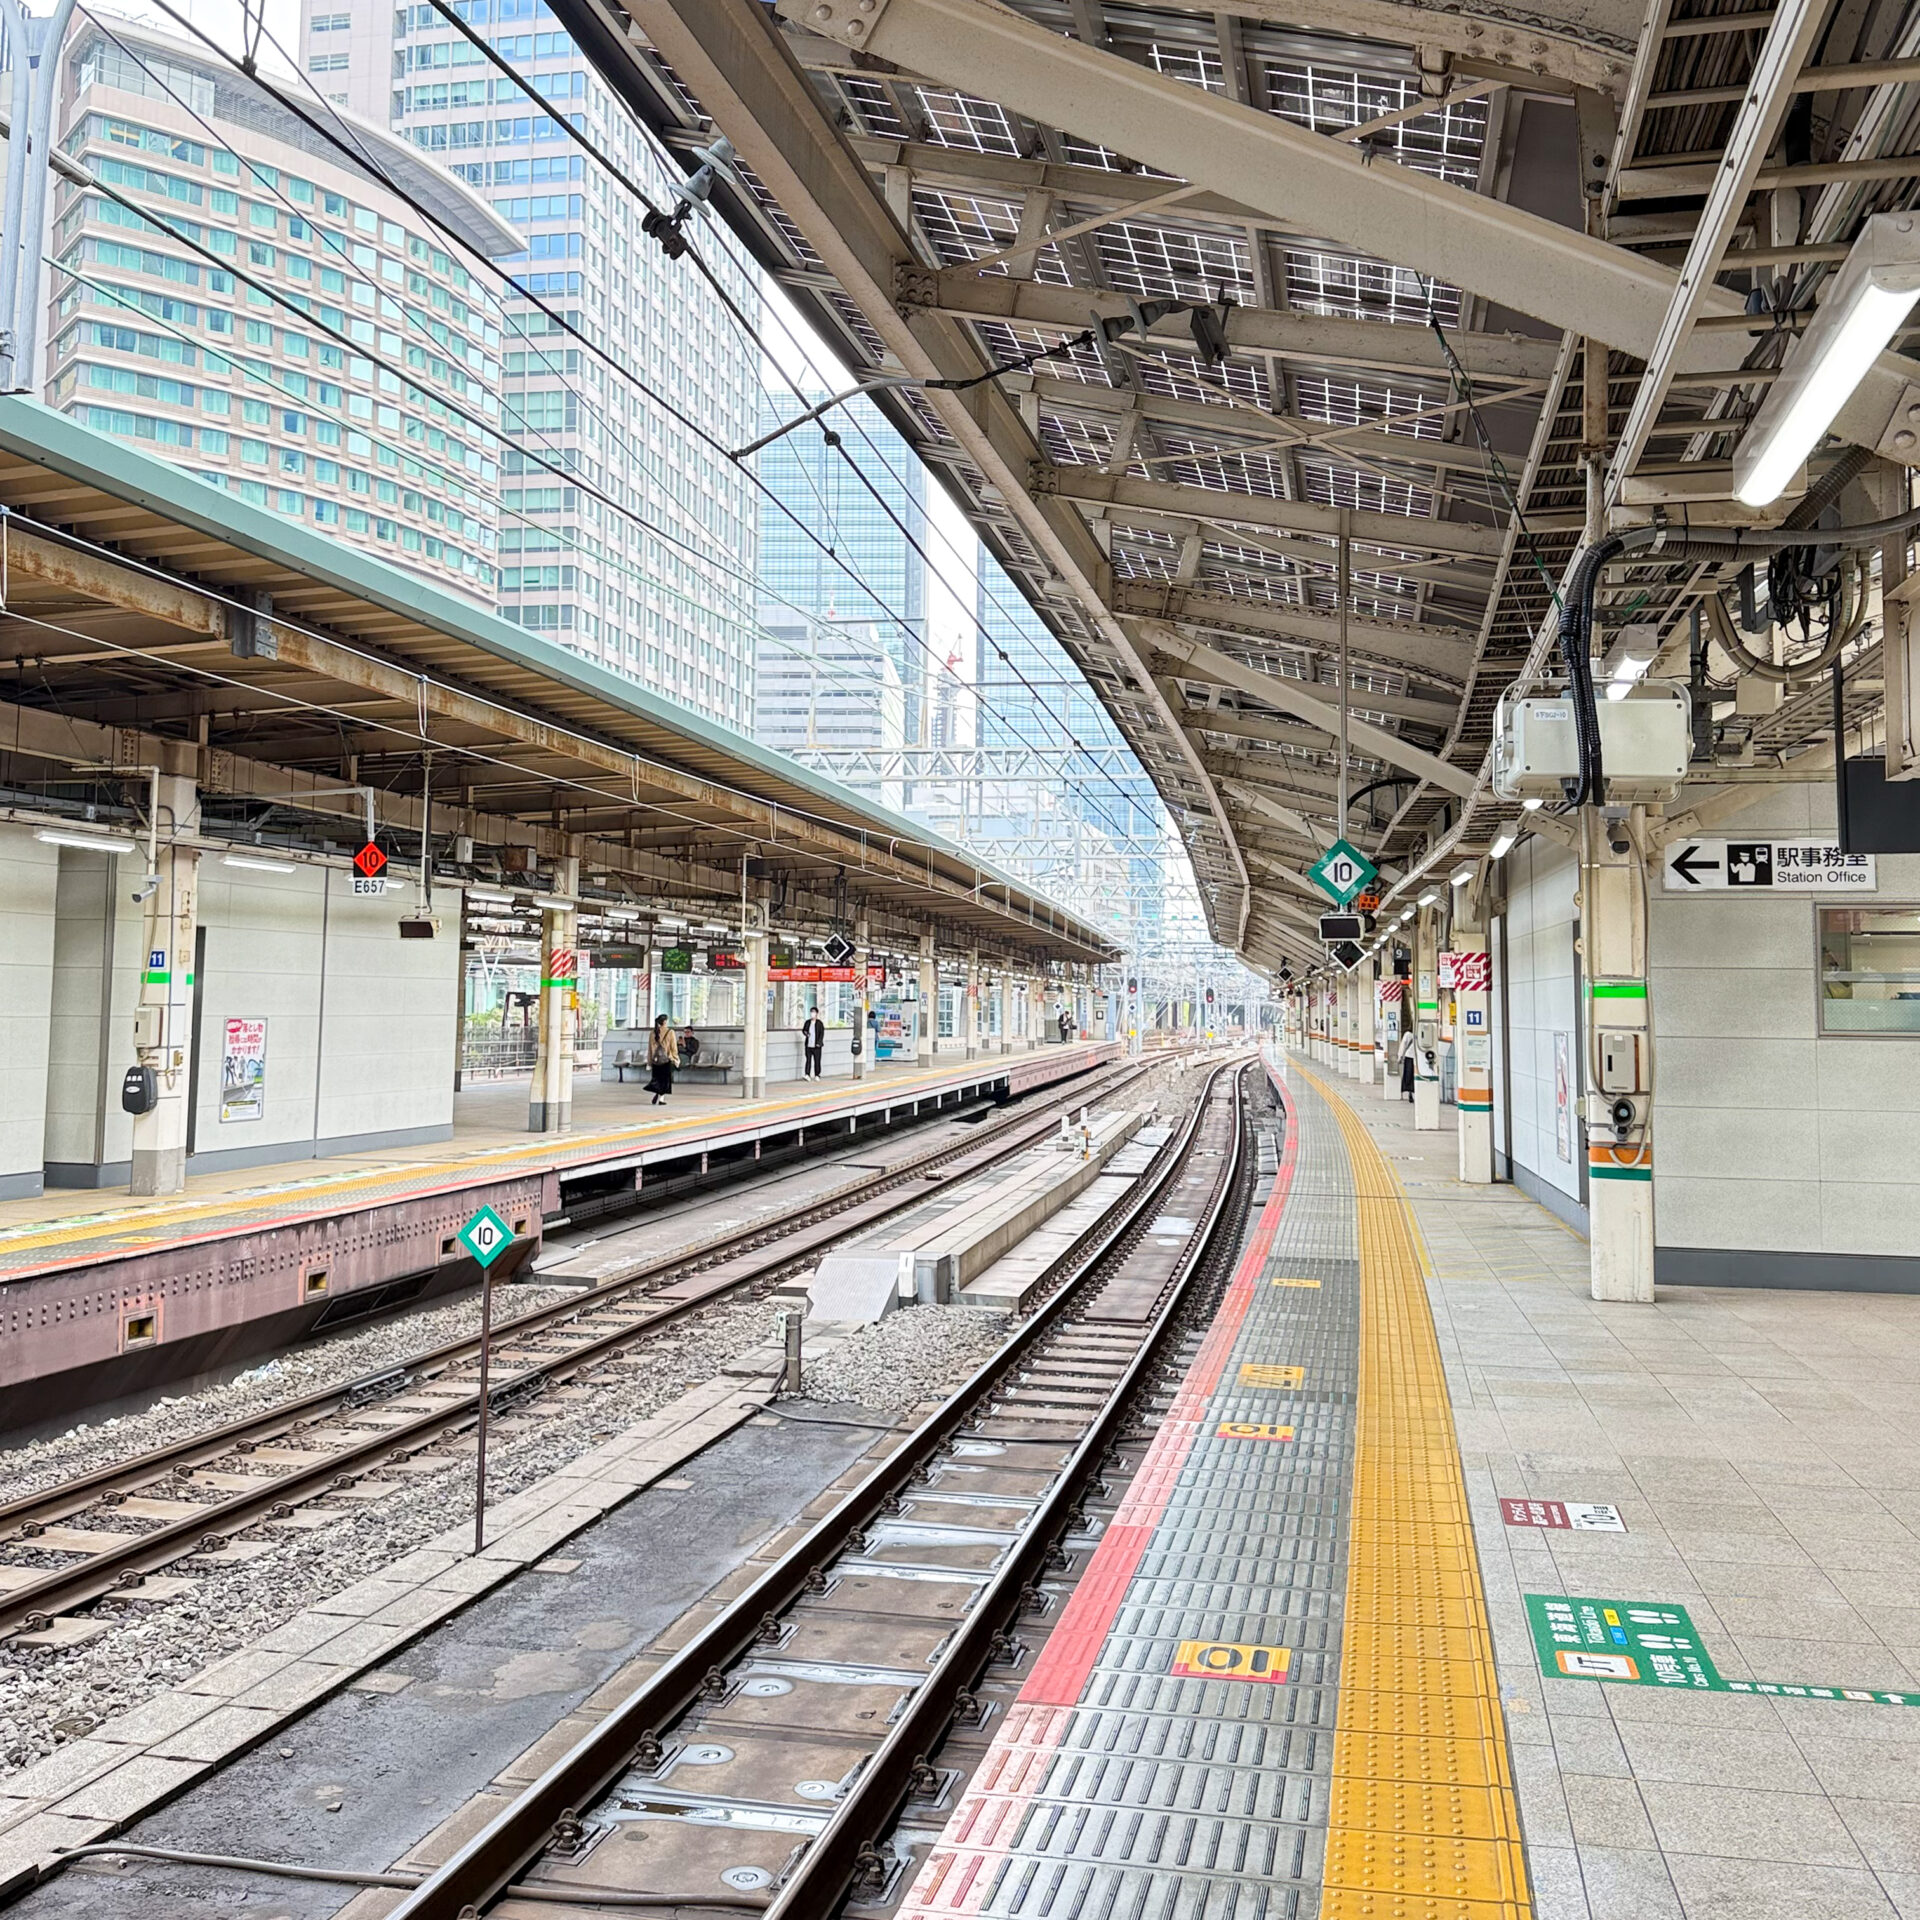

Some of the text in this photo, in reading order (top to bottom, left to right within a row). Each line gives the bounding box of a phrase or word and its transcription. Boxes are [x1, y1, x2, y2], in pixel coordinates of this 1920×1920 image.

[363, 851, 380, 868] 10
[1333, 862, 1353, 883] 10
[1777, 871, 1867, 883] Station Office
[354, 880, 385, 894] E657
[151, 953, 163, 966] 11
[1395, 949, 1403, 959] 9
[1468, 1012, 1480, 1024] 11
[478, 1226, 494, 1246] 10
[1580, 1606, 1597, 1620] Line
[1544, 1602, 1582, 1644] 東海道線
[1577, 1656, 1615, 1673] JT
[1649, 1653, 1689, 1684] 10号車
